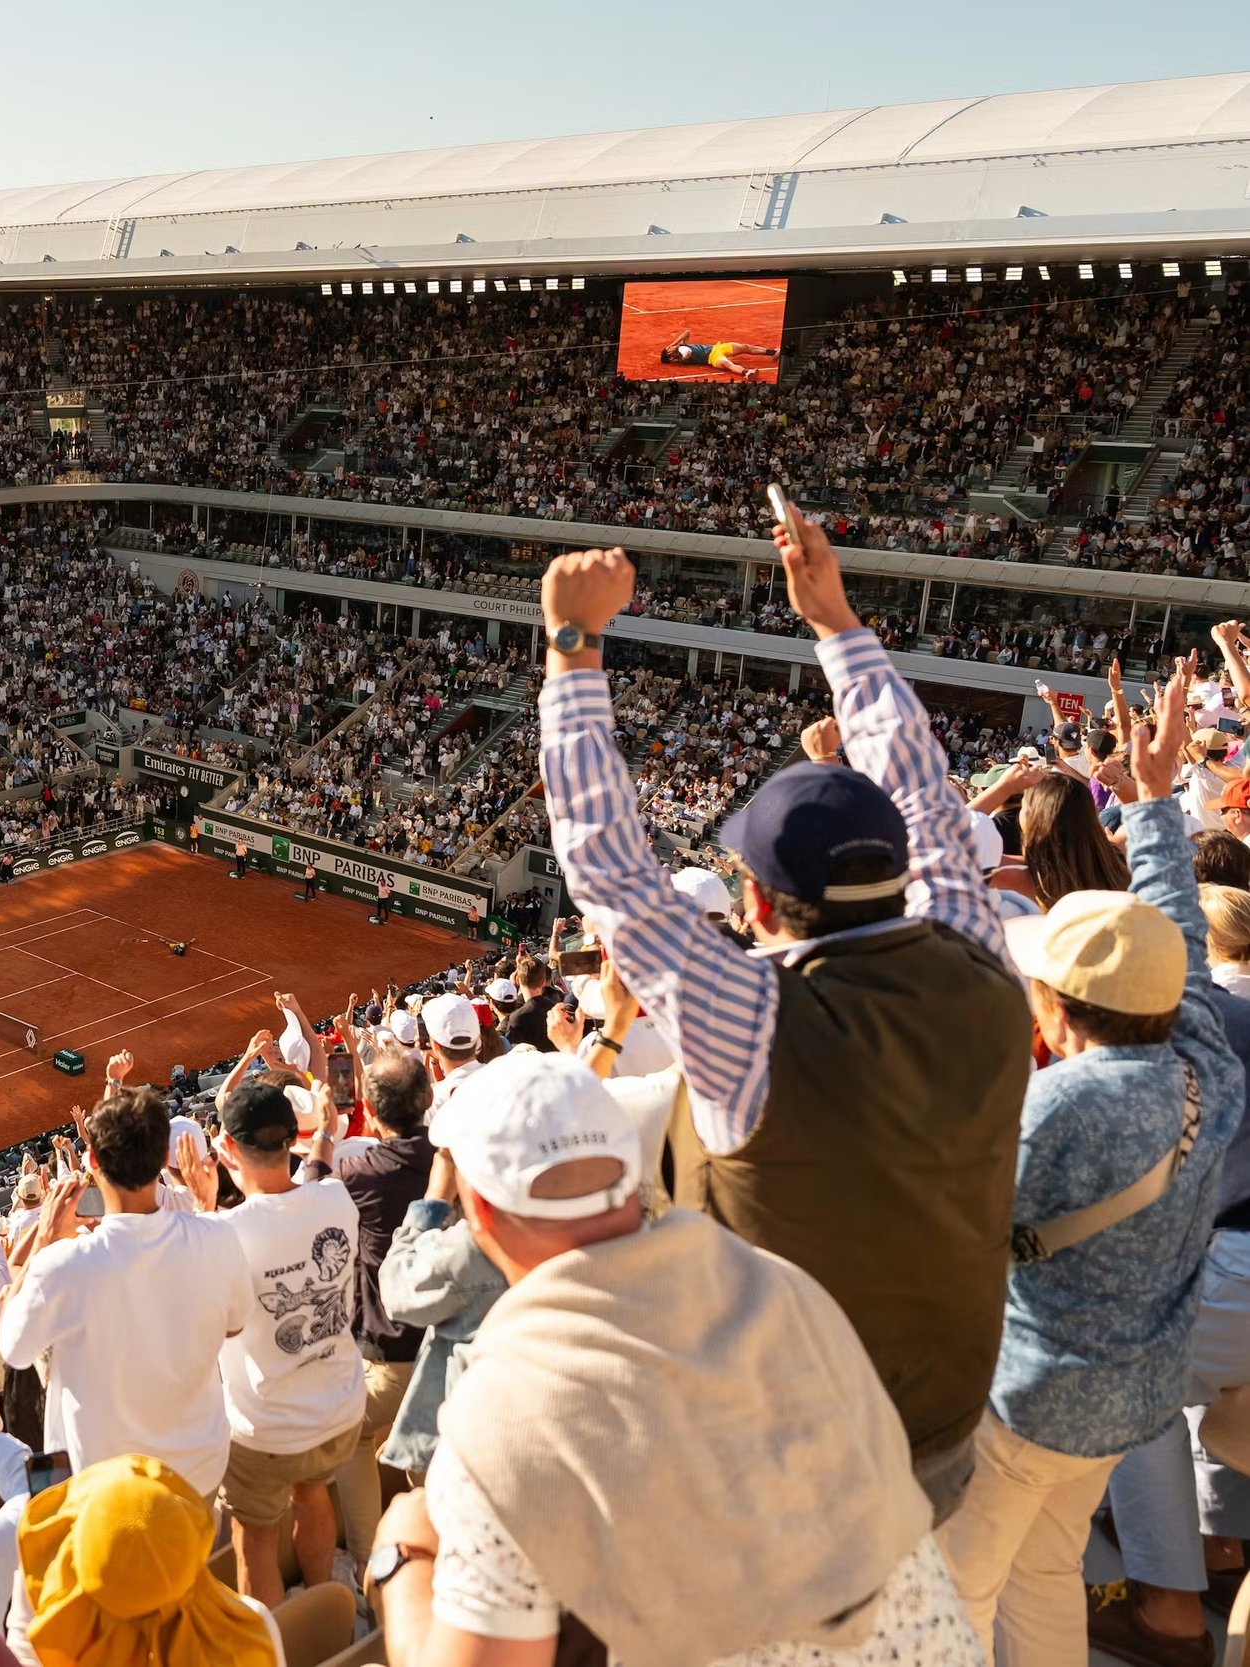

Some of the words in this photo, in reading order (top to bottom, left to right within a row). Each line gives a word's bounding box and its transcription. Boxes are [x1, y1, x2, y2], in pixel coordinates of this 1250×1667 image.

[473, 600, 507, 612] COURT
[1060, 697, 1079, 710] TEN
[144, 754, 186, 777] Emirates
[188, 766, 201, 781] FLY
[200, 770, 224, 787] BETTER
[153, 826, 165, 836] 153
[215, 825, 228, 835] BNP
[229, 830, 255, 844] PARIBAS
[276, 865, 288, 874] BNP
[293, 846, 321, 865] BNP
[334, 858, 395, 888] PARIBAS
[342, 885, 355, 894] BNP
[422, 885, 439, 896] BNP
[439, 890, 472, 906] PARIBAS
[415, 907, 428, 917] BNP
[428, 911, 456, 925] PARIBAS
[55, 1058, 70, 1070] Haier
